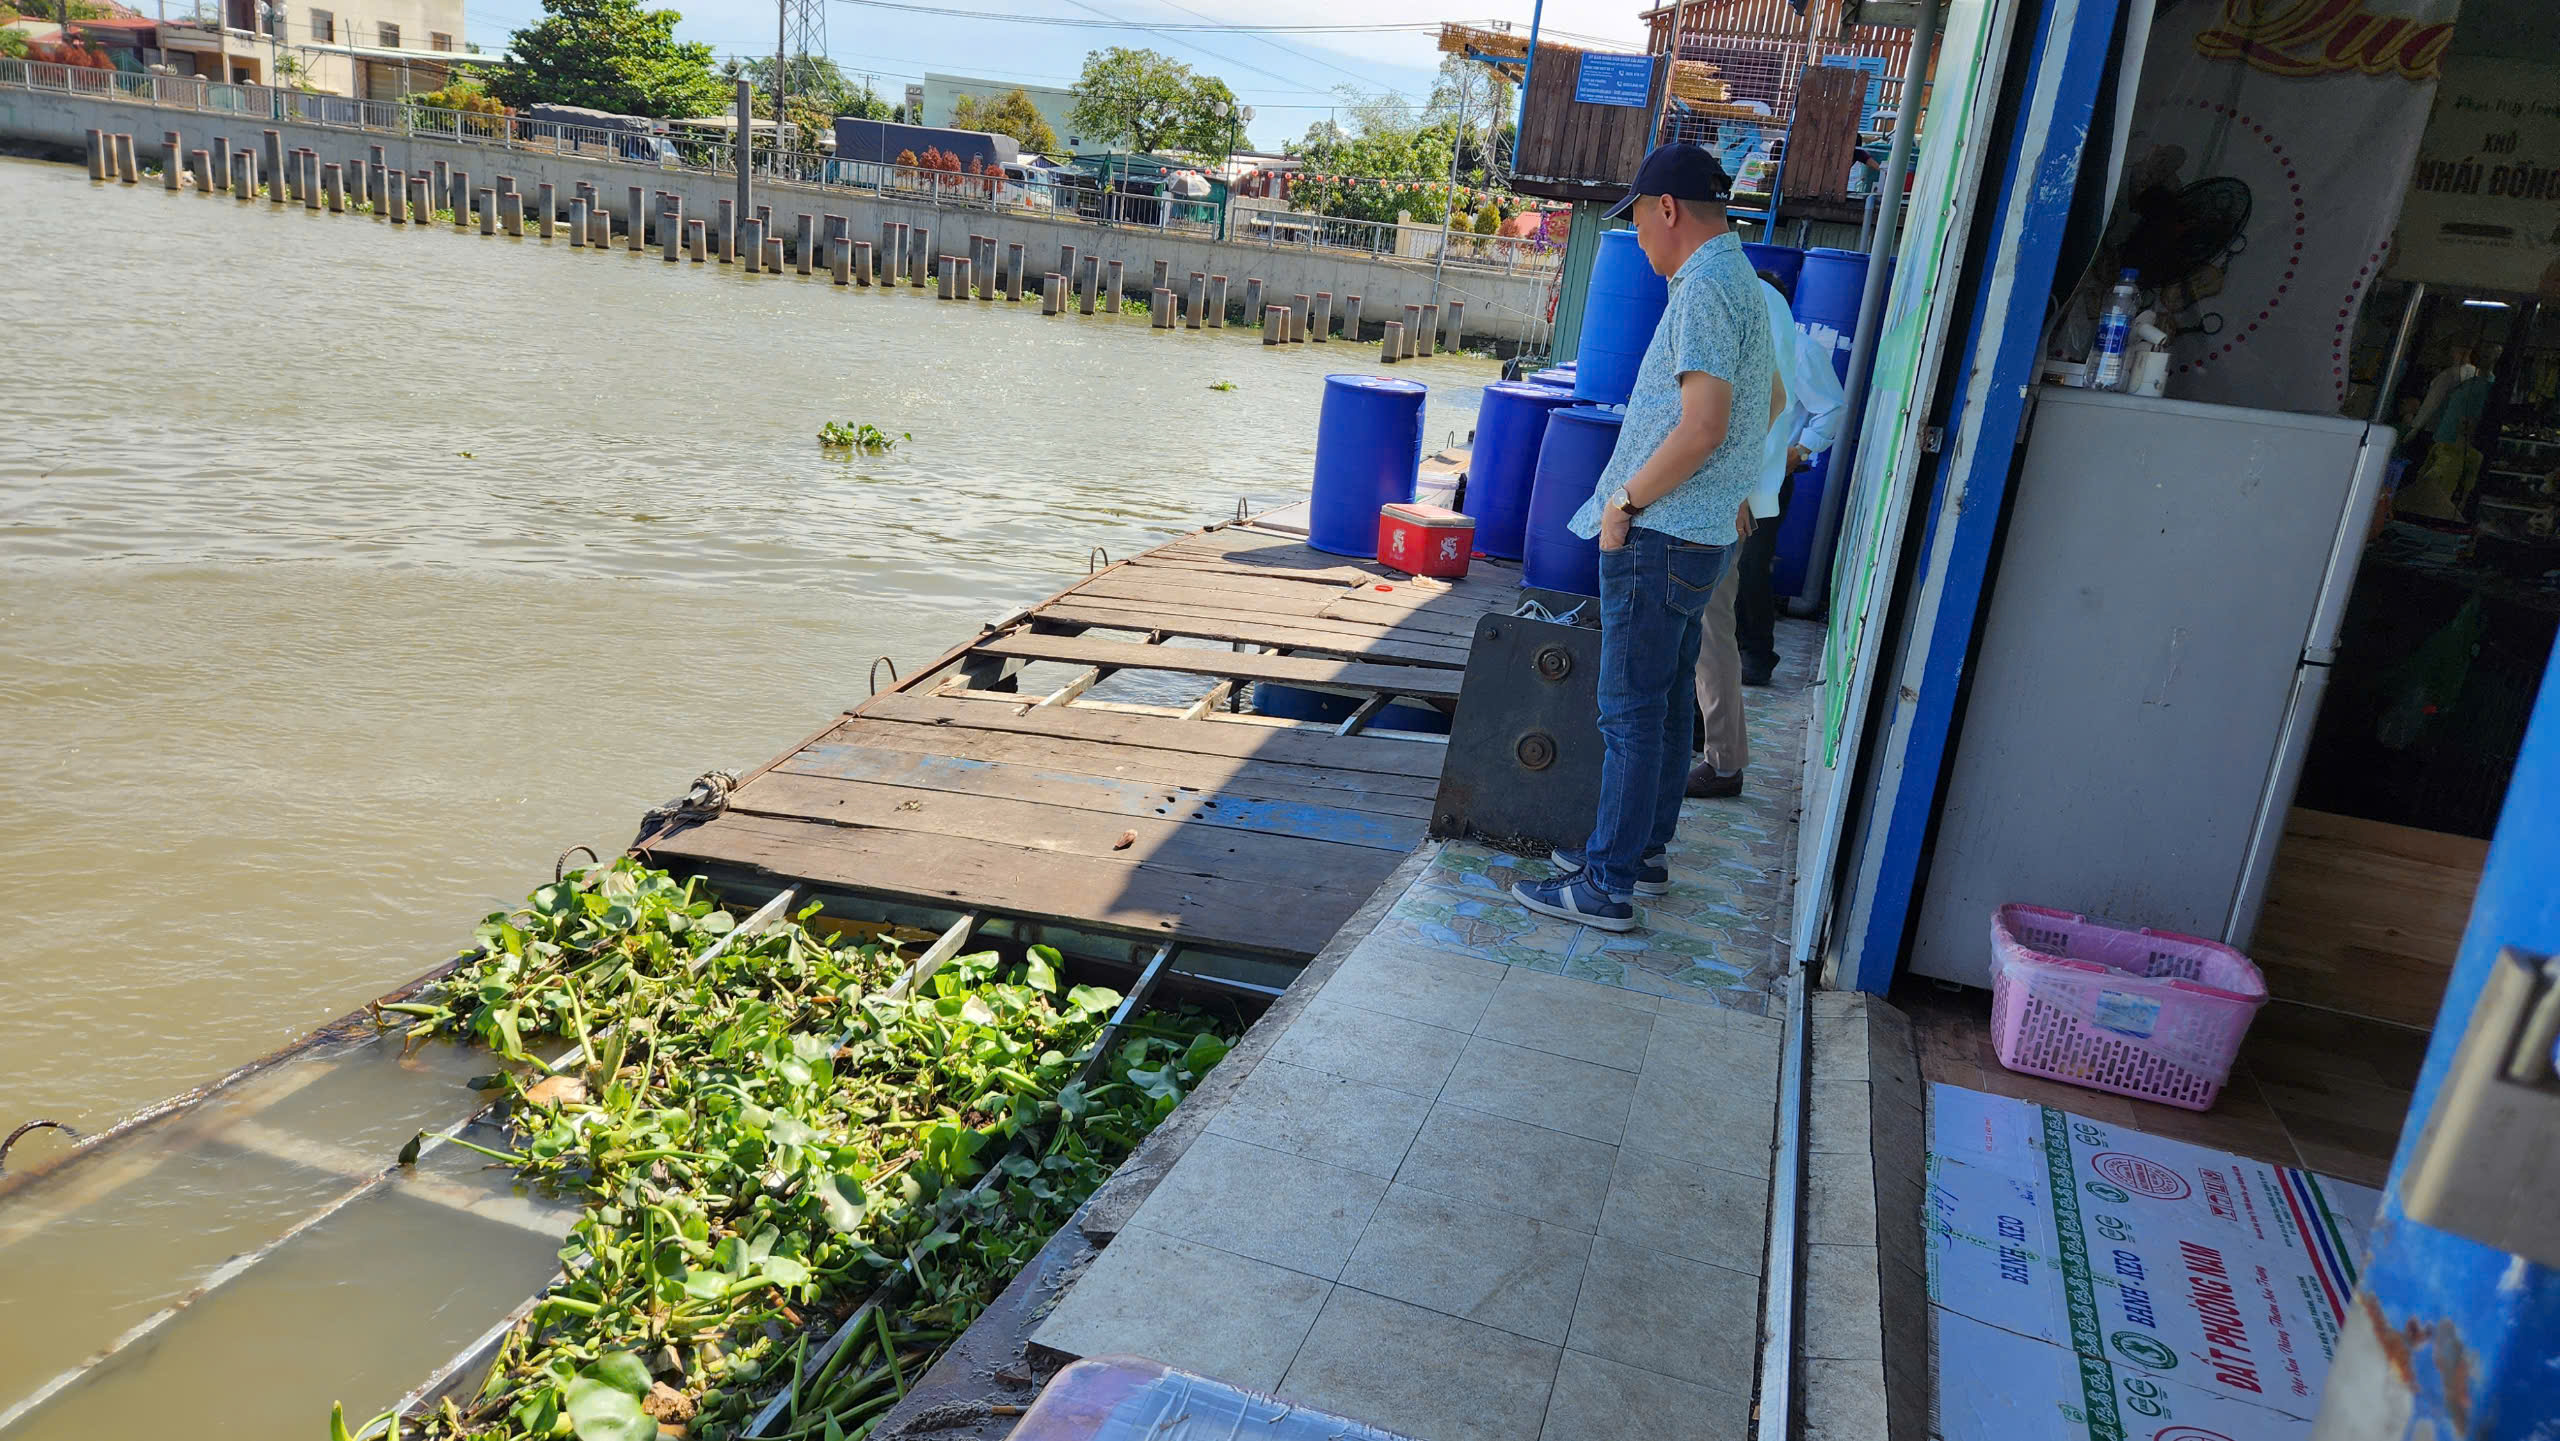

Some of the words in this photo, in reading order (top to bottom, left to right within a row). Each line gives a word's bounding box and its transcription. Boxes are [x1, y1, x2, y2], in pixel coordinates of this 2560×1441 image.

[2178, 1240, 2229, 1280] NAM
[2114, 1283, 2156, 1329] BÁNH
[2185, 1276, 2252, 1352] PHƯƠNG
[2190, 1347, 2263, 1394] ĐẤT
